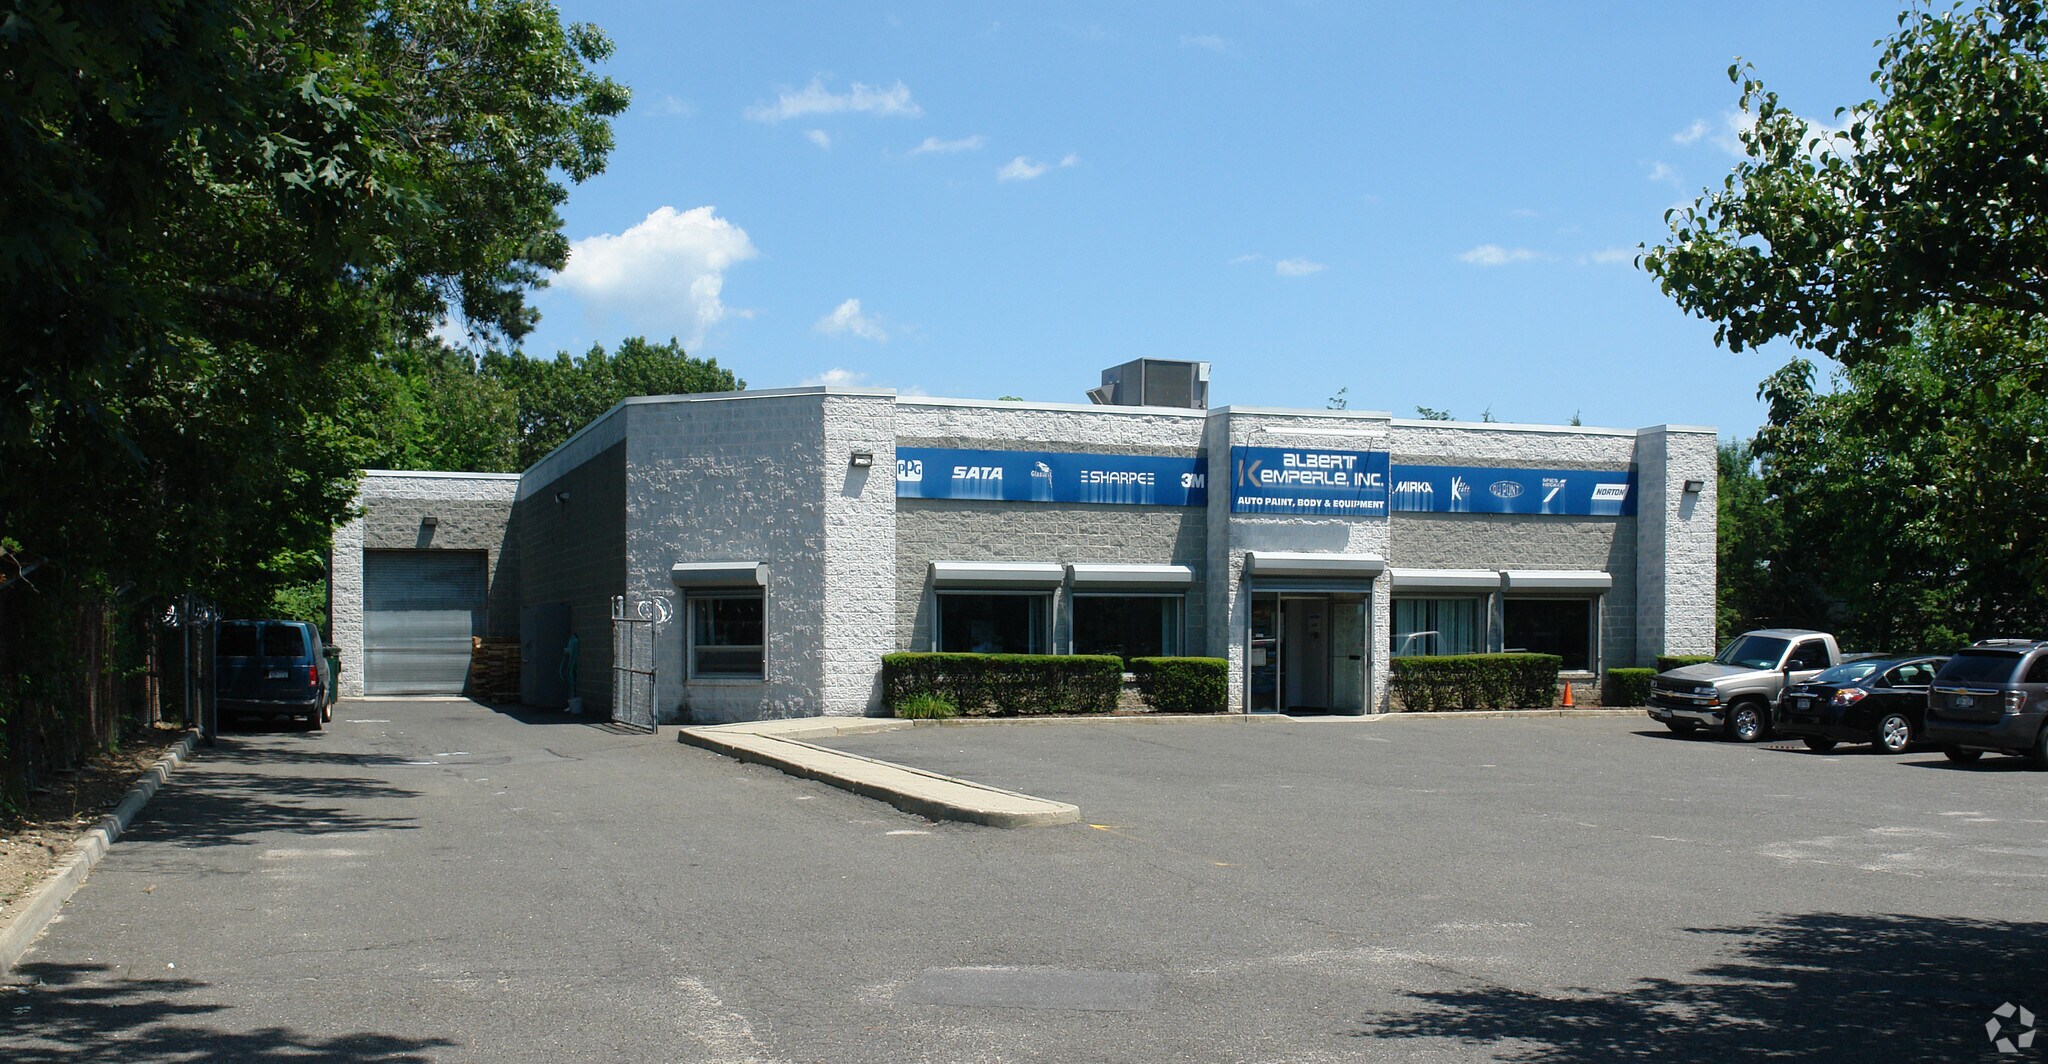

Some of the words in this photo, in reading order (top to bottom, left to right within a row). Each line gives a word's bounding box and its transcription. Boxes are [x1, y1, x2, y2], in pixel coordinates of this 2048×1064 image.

[898, 459, 921, 477] PPG
[1283, 453, 1357, 469] ALBERT
[952, 465, 1003, 480] SATA
[1354, 472, 1385, 487] INC.
[1181, 473, 1205, 488] 3M
[1394, 481, 1433, 493] MIRKA
[1596, 487, 1625, 496] NORTON
[1237, 496, 1263, 505] AUTO
[1264, 497, 1296, 508] PAINT,
[1297, 498, 1322, 508] BODY
[1325, 499, 1331, 508] &
[1333, 499, 1385, 509] EQUIPMENT
